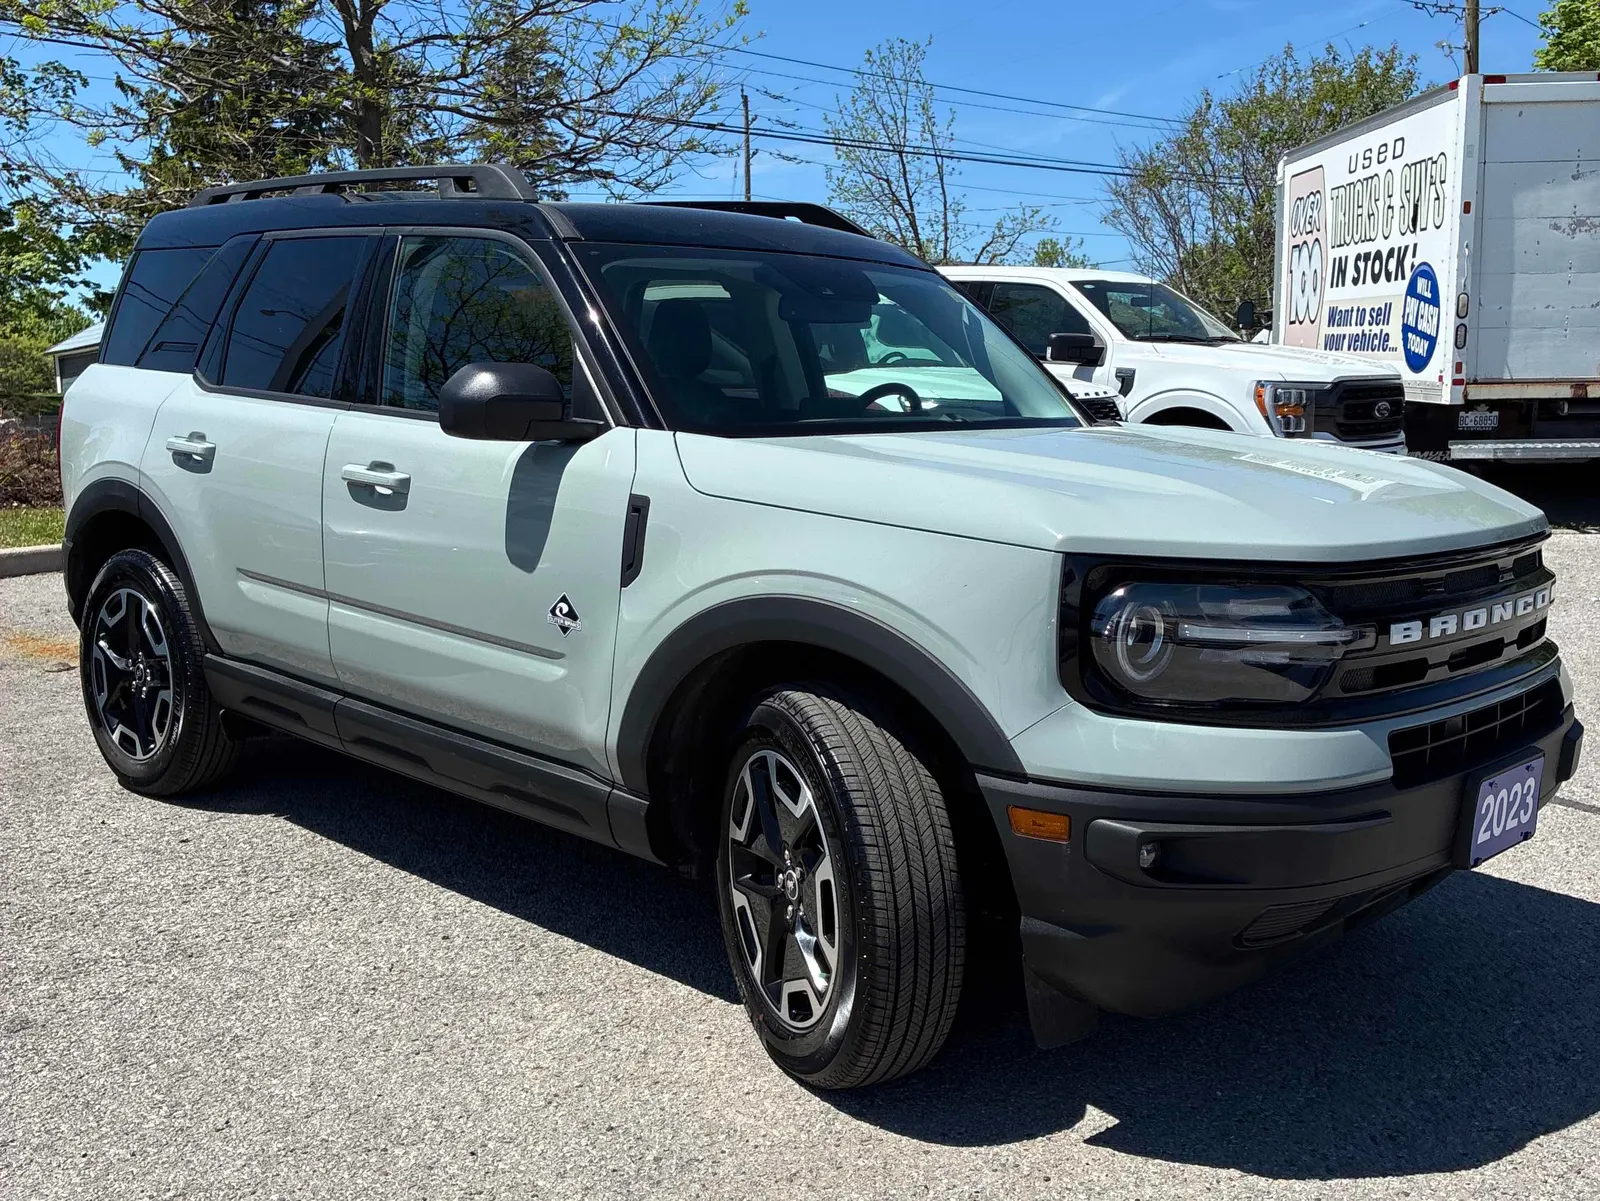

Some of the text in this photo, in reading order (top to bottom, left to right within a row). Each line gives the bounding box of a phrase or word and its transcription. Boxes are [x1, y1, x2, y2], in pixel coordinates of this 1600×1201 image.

[1348, 137, 1405, 175] USED
[1291, 190, 1321, 238] OVER
[1331, 173, 1380, 249] TRUCKS
[1382, 169, 1394, 240] &
[1289, 238, 1322, 325] 100
[1330, 255, 1348, 288] IN
[1417, 276, 1432, 298] WILL
[1327, 302, 1392, 328] Want to sell
[1404, 295, 1439, 337] PAY CASH
[1324, 333, 1346, 352] your
[1407, 332, 1429, 357] TODAY
[1389, 588, 1549, 646] BRONCO
[1477, 777, 1535, 845] 2023
